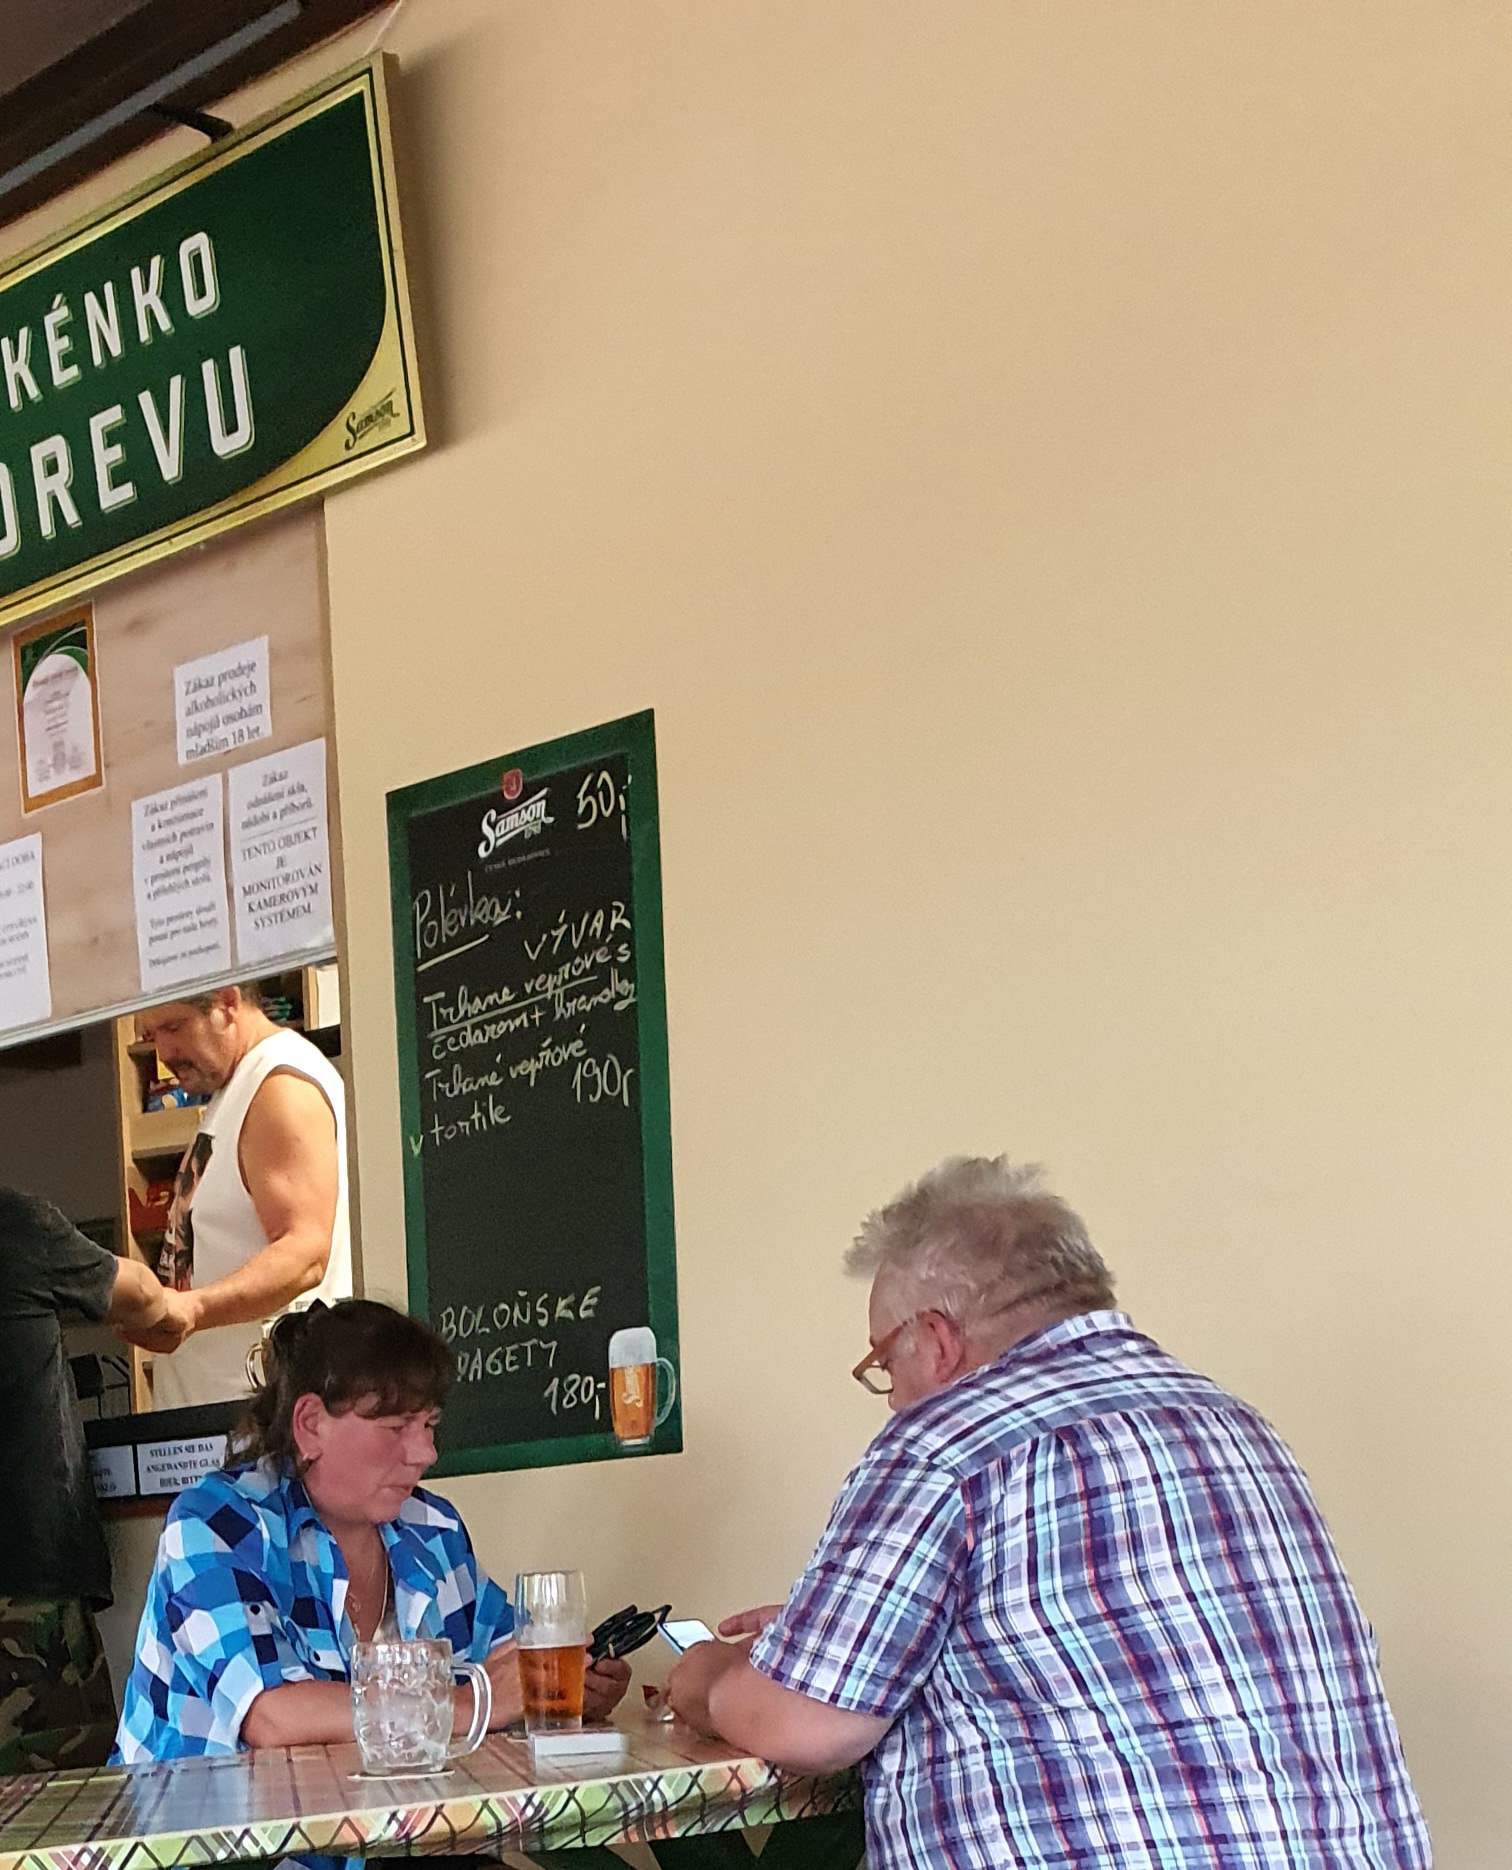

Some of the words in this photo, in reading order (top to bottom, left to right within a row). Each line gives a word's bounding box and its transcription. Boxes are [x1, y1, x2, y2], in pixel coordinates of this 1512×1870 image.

[345, 388, 400, 450] Samson
[232, 728, 245, 746] 18
[477, 787, 555, 859] Samson
[275, 854, 287, 870] JE
[524, 901, 632, 960] VÝVAR
[457, 1337, 559, 1383] PAGETY
